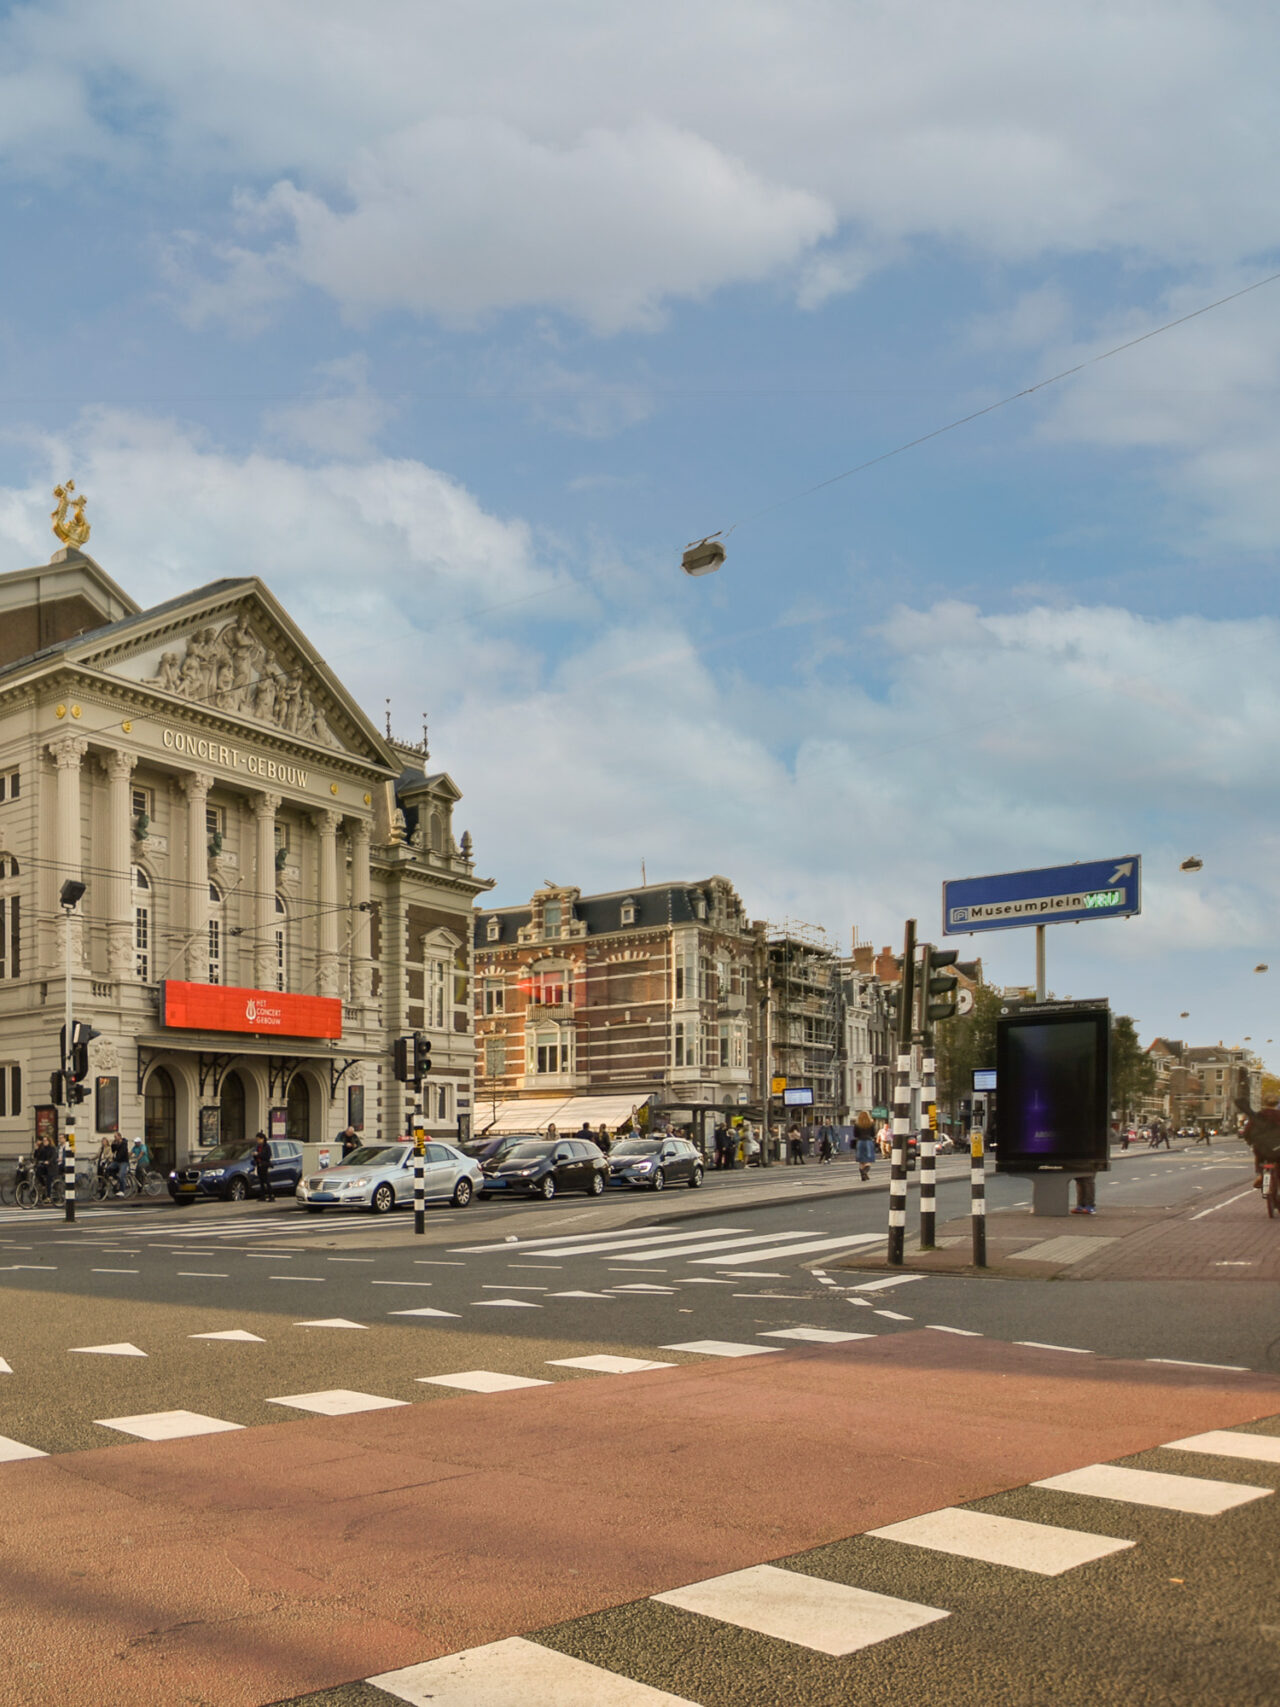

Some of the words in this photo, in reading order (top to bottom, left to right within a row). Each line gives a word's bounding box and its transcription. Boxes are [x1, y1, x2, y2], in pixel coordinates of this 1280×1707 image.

[162, 728, 309, 788] CONCERT-GEBOUW
[971, 897, 1082, 918] Museumplein
[256, 1008, 281, 1016] CONCERT
[256, 1016, 281, 1025] GEBOUW
